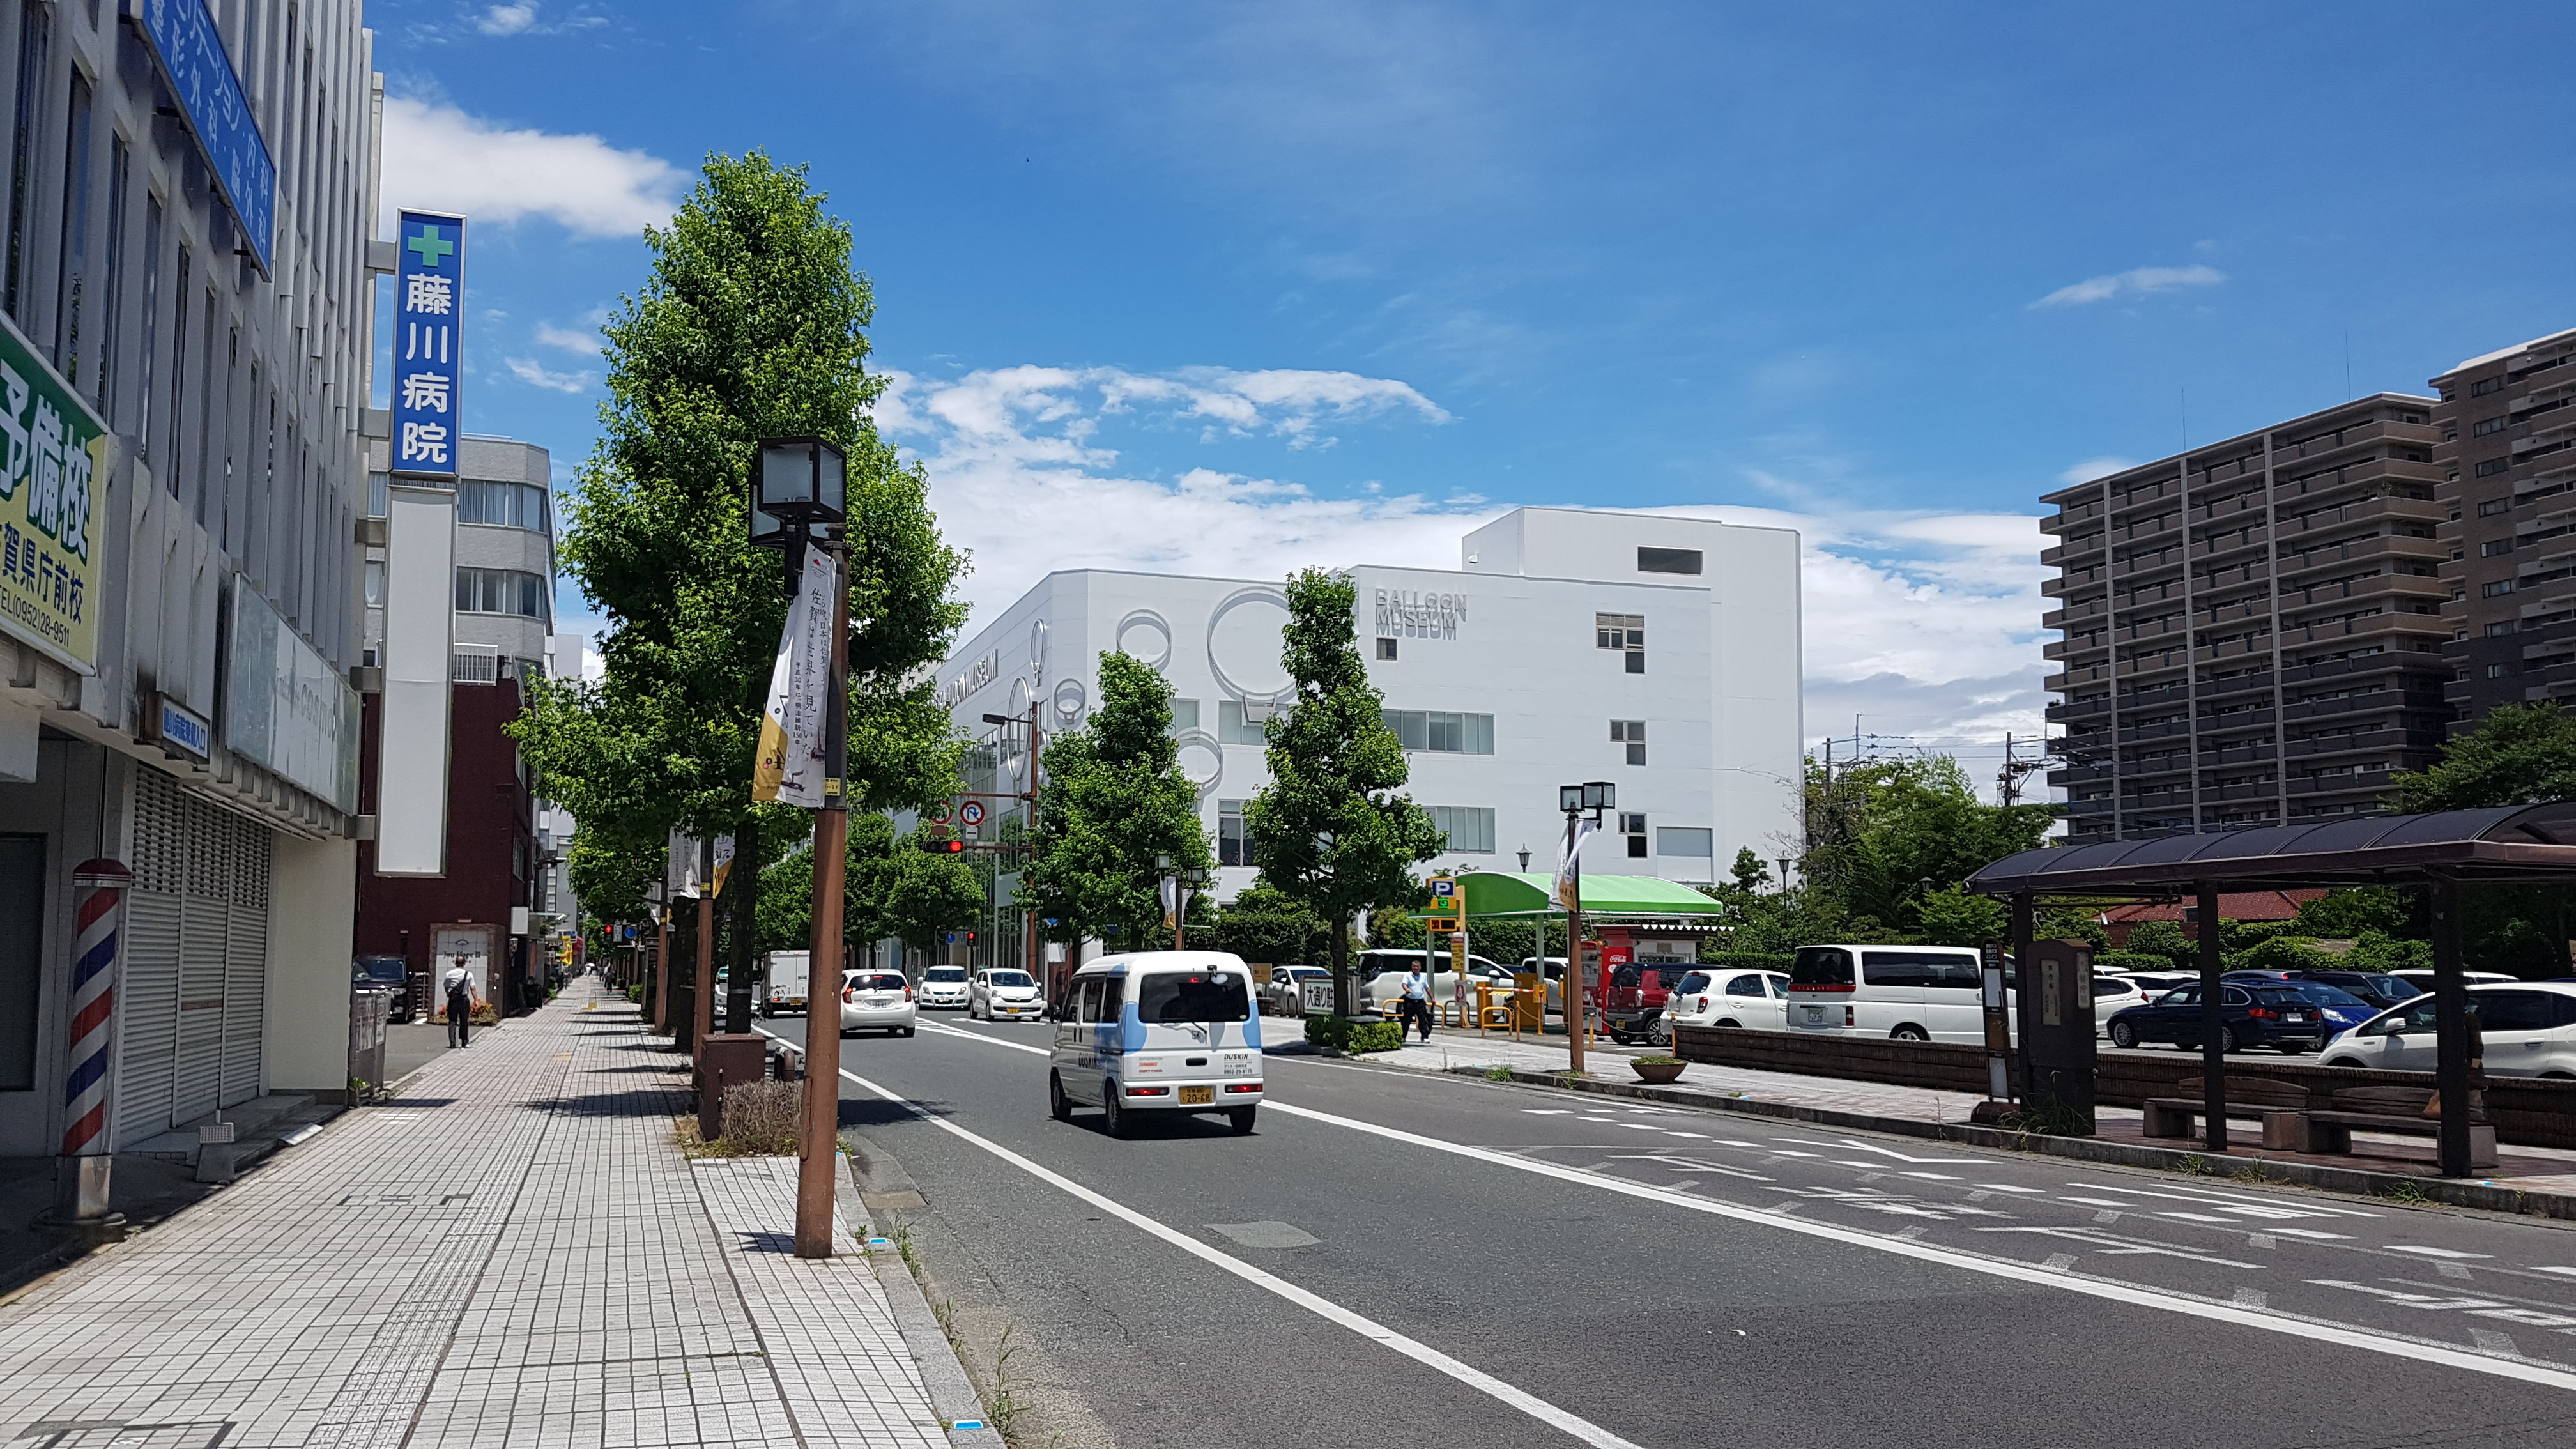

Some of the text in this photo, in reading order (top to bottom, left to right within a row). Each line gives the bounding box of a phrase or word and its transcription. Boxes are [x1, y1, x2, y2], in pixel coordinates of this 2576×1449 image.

[402, 272, 452, 463] 藤川病院
[0, 520, 84, 626] 賀県庁前校
[1376, 588, 1467, 611] BALLOON
[1376, 607, 1457, 630] MUSEUM
[1186, 1093, 1211, 1103] 20-68
